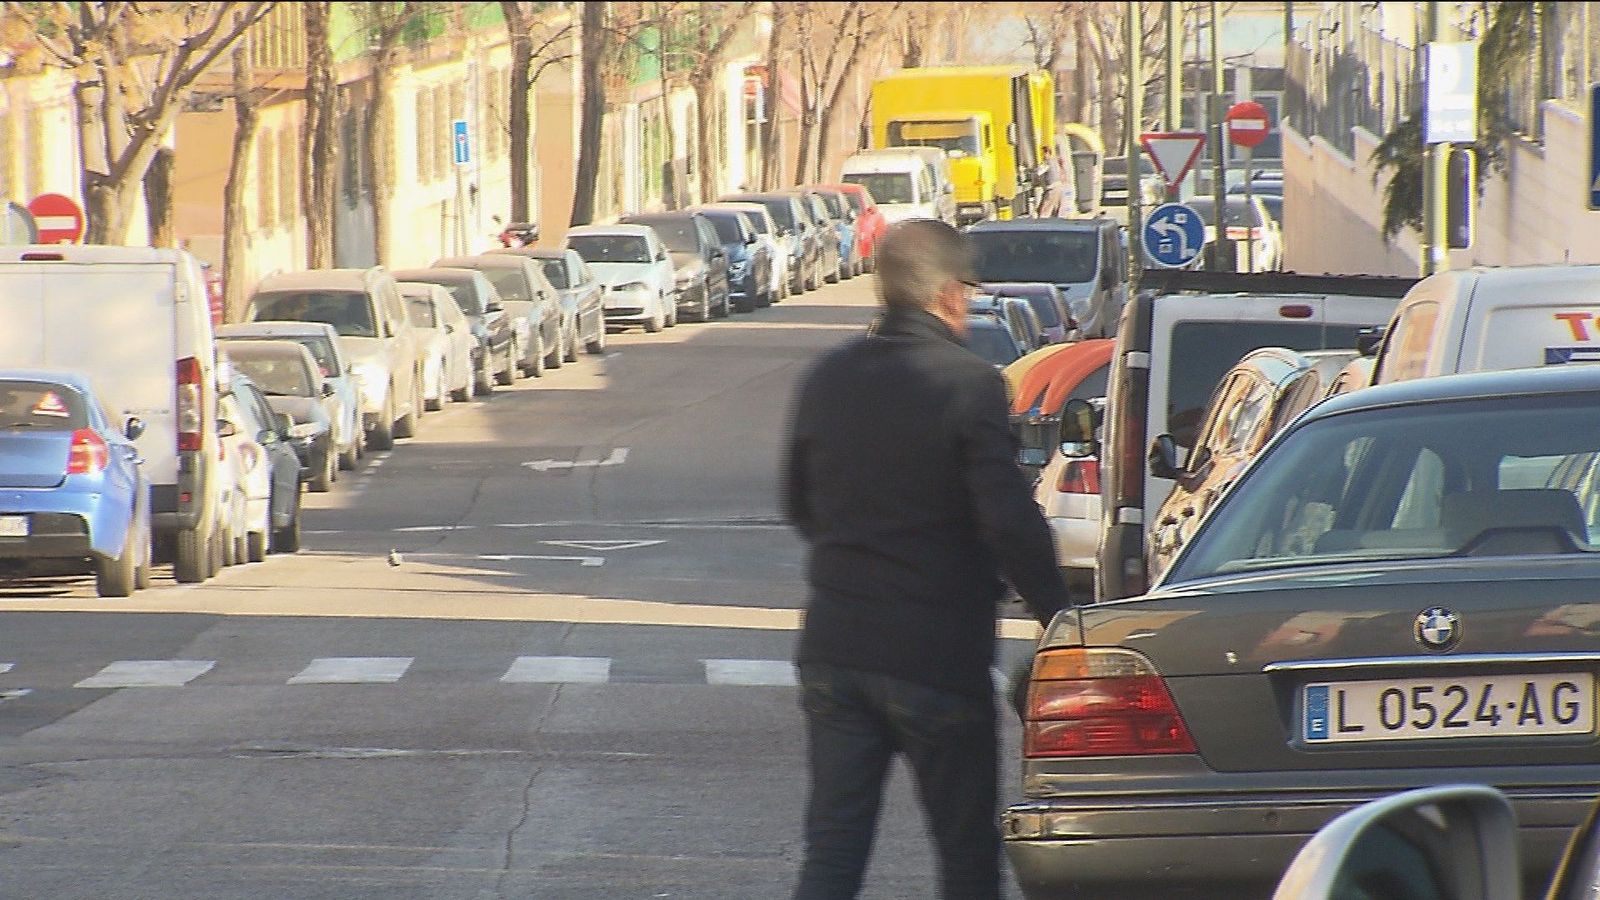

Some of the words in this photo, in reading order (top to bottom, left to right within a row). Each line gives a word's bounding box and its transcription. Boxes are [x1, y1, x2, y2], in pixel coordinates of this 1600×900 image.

[1553, 312, 1600, 341] T
[1312, 719, 1323, 731] E
[1338, 690, 1364, 733] L
